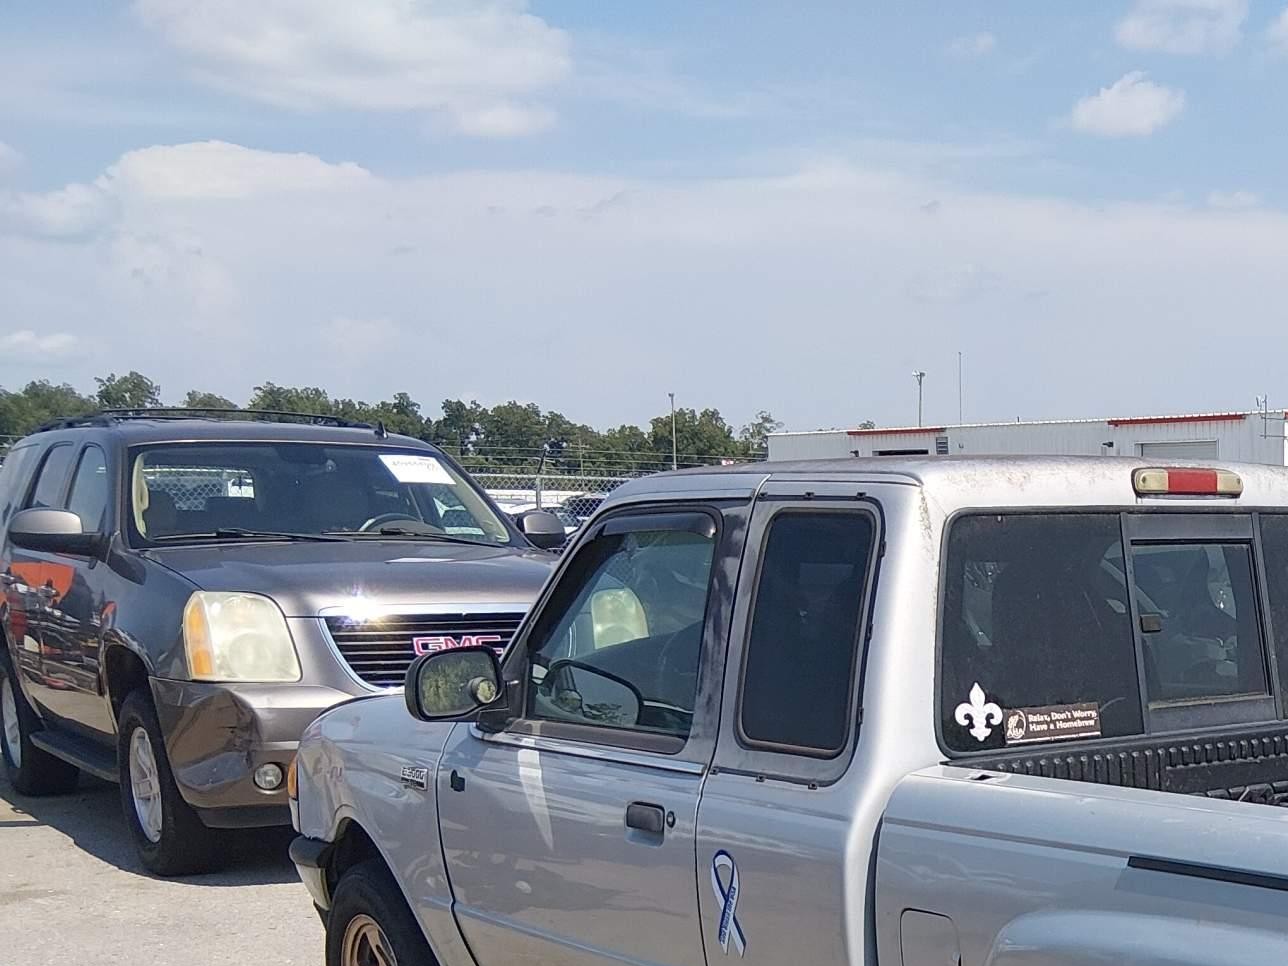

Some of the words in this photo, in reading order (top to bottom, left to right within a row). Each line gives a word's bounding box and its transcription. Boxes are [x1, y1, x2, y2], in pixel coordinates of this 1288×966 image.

[413, 635, 503, 656] GMC
[1051, 711, 1071, 720] Don't
[1029, 723, 1047, 732] Have
[1056, 720, 1095, 729] Homebrew
